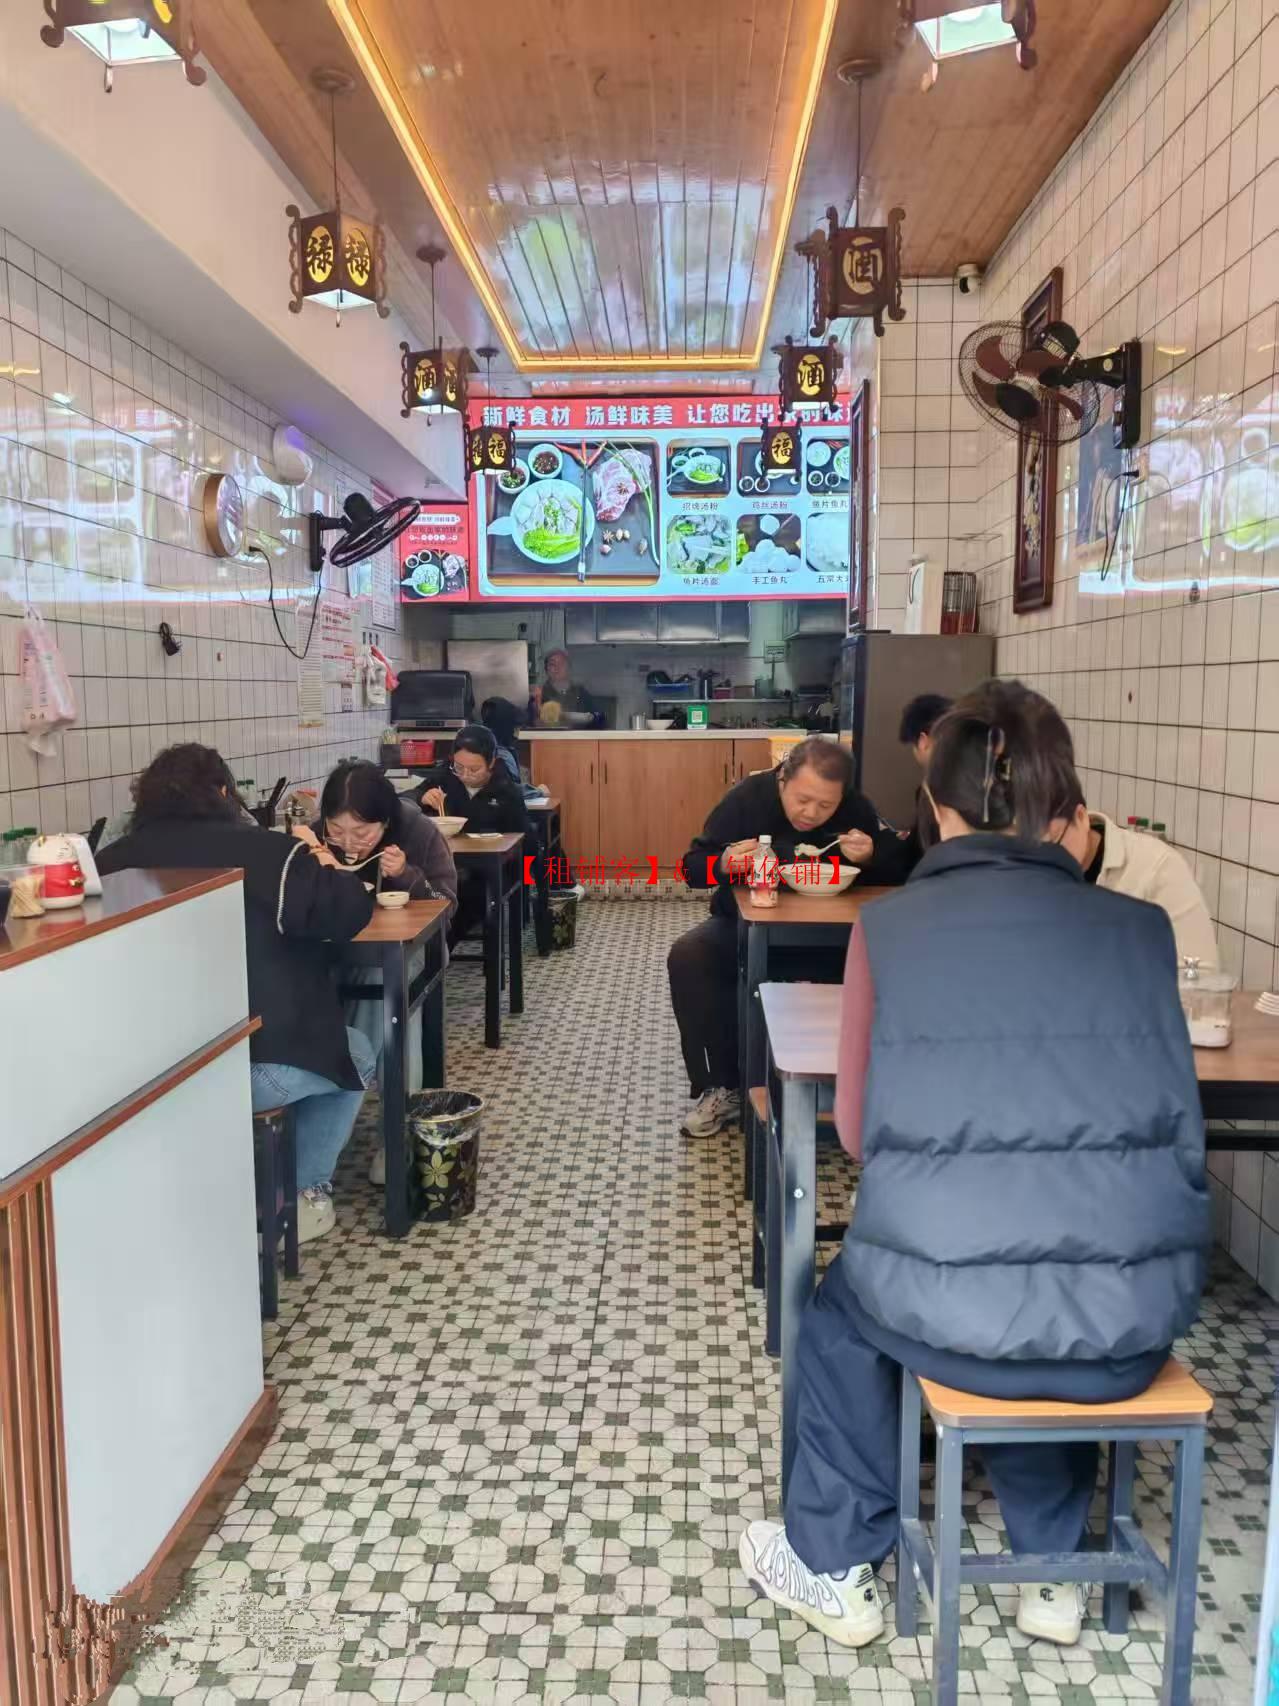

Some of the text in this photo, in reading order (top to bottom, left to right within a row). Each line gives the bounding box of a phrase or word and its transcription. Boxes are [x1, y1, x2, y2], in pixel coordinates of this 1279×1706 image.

[798, 360, 822, 387] 酒
[482, 405, 571, 426] 新鲜食材
[585, 405, 673, 426] 汤鲜味美
[487, 437, 506, 458] 福
[772, 439, 792, 458] 福
[752, 576, 788, 585] 手工鱼丸
